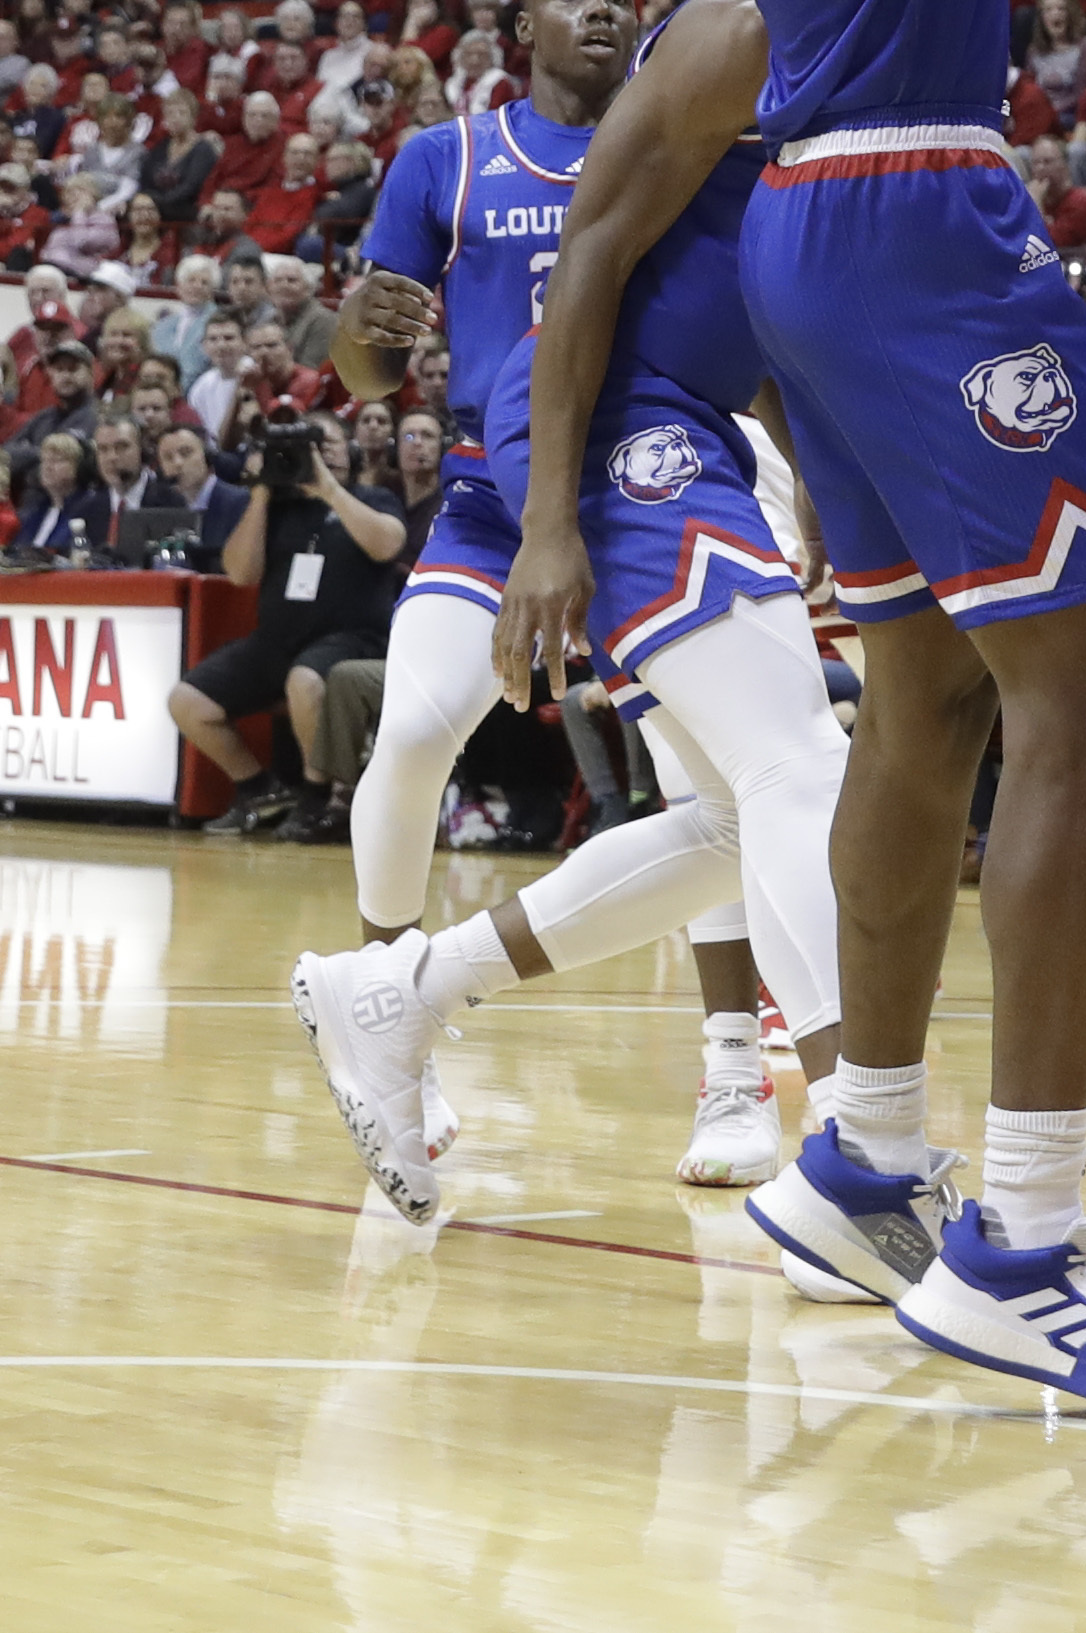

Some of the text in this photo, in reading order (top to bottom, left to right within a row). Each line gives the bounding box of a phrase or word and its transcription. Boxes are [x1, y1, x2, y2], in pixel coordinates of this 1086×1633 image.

[479, 164, 518, 176] adidas
[484, 204, 570, 238] LOUI
[1019, 250, 1060, 273] adidas
